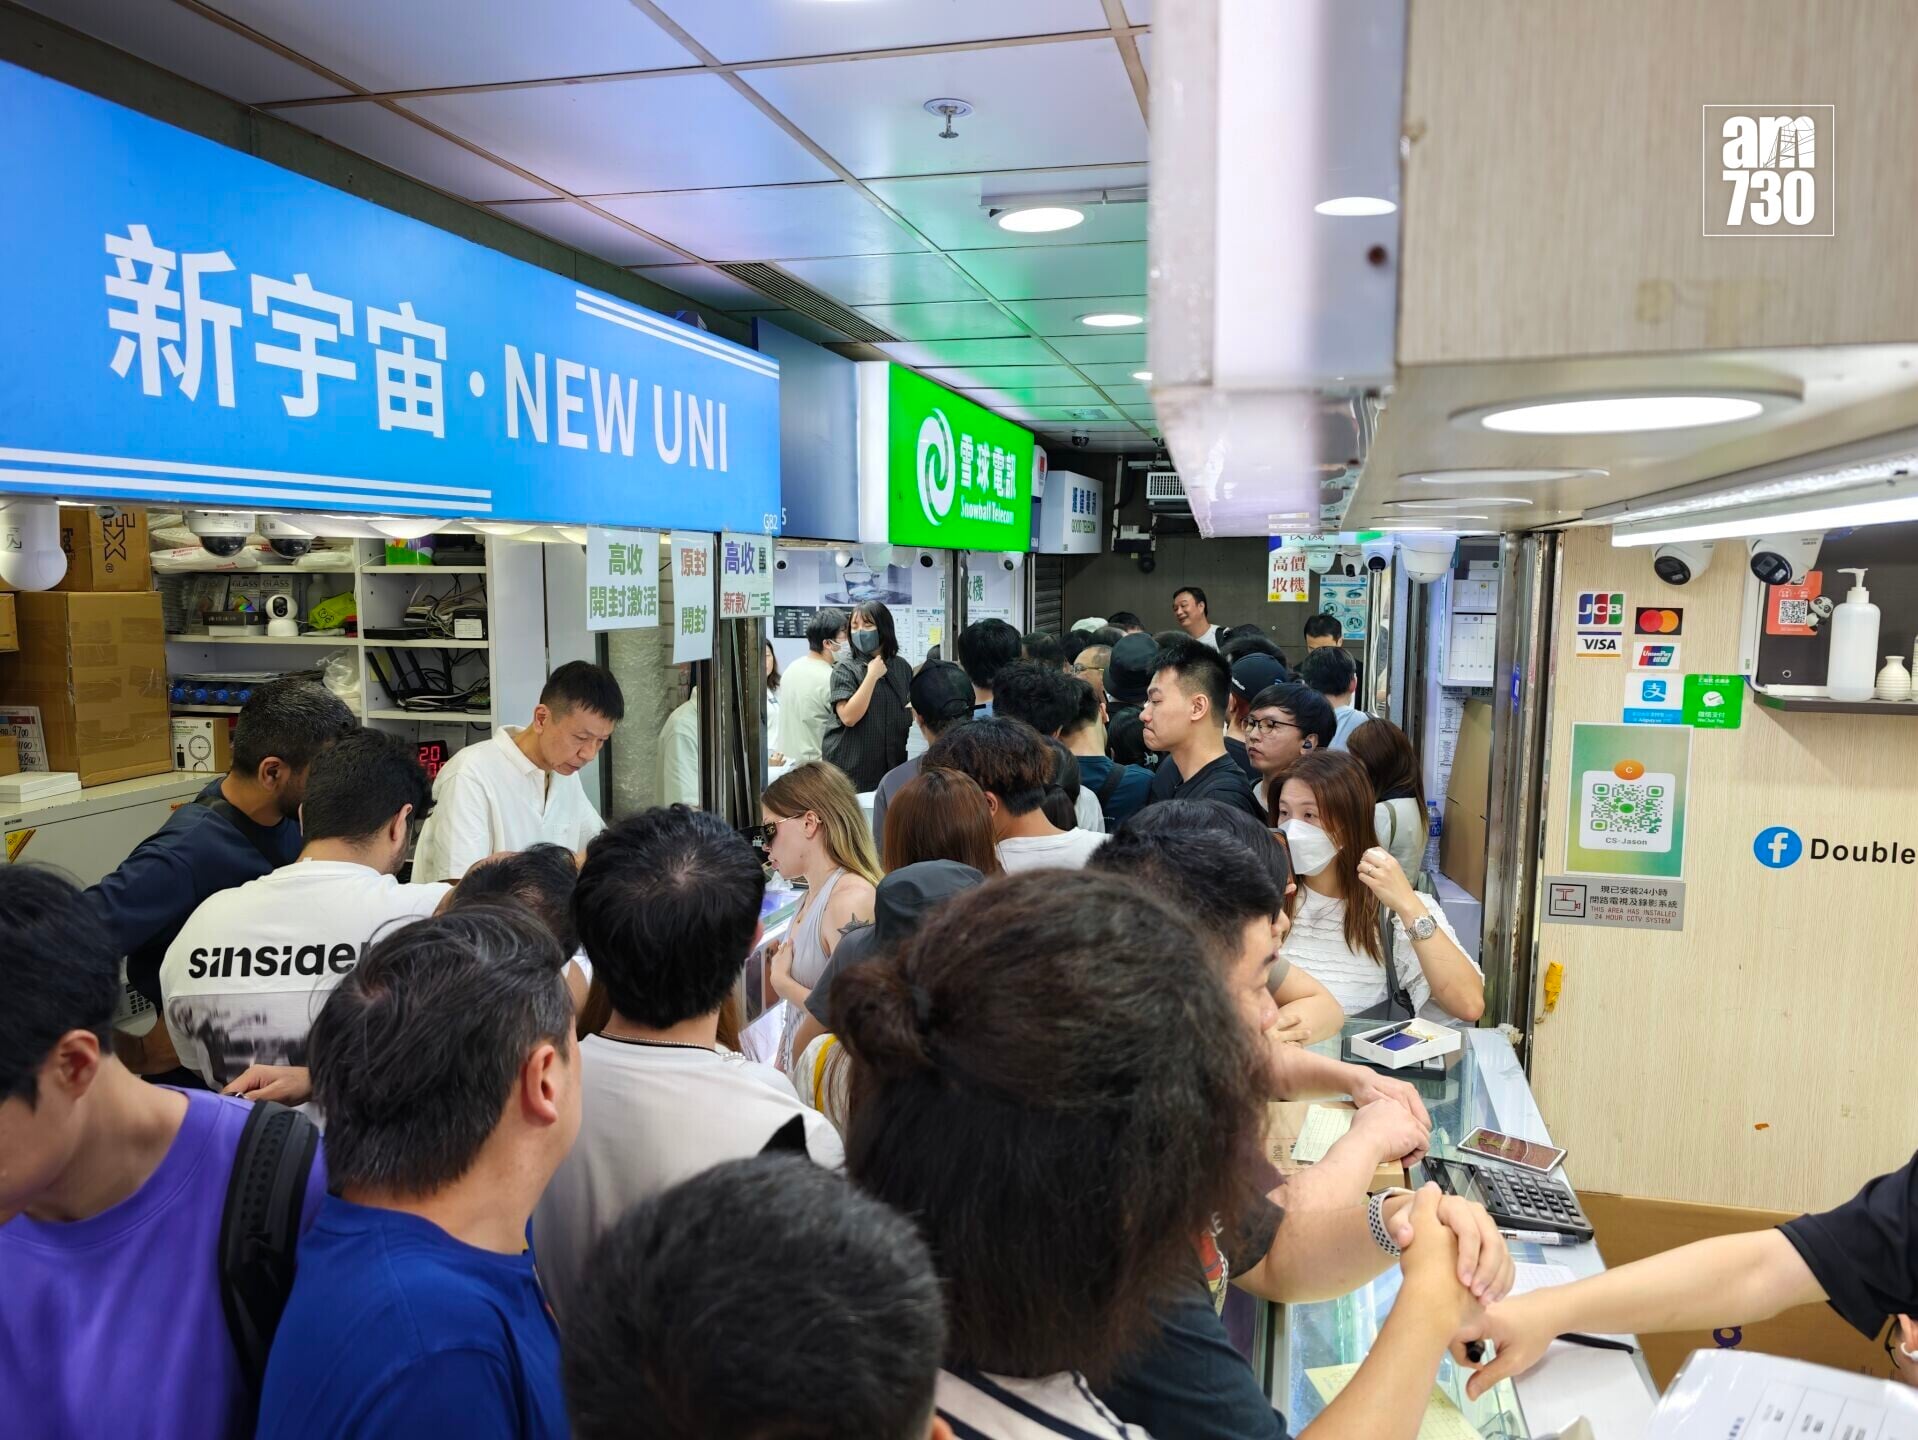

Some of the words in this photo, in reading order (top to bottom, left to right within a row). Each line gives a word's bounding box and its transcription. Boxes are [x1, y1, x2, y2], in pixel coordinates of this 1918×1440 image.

[104, 224, 447, 440] 新宇宙
[504, 344, 638, 457] NEW
[654, 385, 729, 472] UNI
[608, 542, 643, 576] 高收
[680, 547, 707, 577] 原封
[724, 541, 756, 575] 高收
[1272, 555, 1306, 573] 高價
[1272, 577, 1306, 593] 收機
[589, 585, 657, 619] 開封激活
[1578, 603, 1622, 615] JCB
[681, 605, 707, 636] 開封
[1582, 638, 1617, 650] VISA
[1810, 838, 1916, 865] Double
[1600, 885, 1668, 897] 現已安裝24小時
[1591, 905, 1604, 913] THIS
[1607, 906, 1624, 914] AREA
[1627, 907, 1641, 915] HAS
[1643, 908, 1677, 917] INSTALLED
